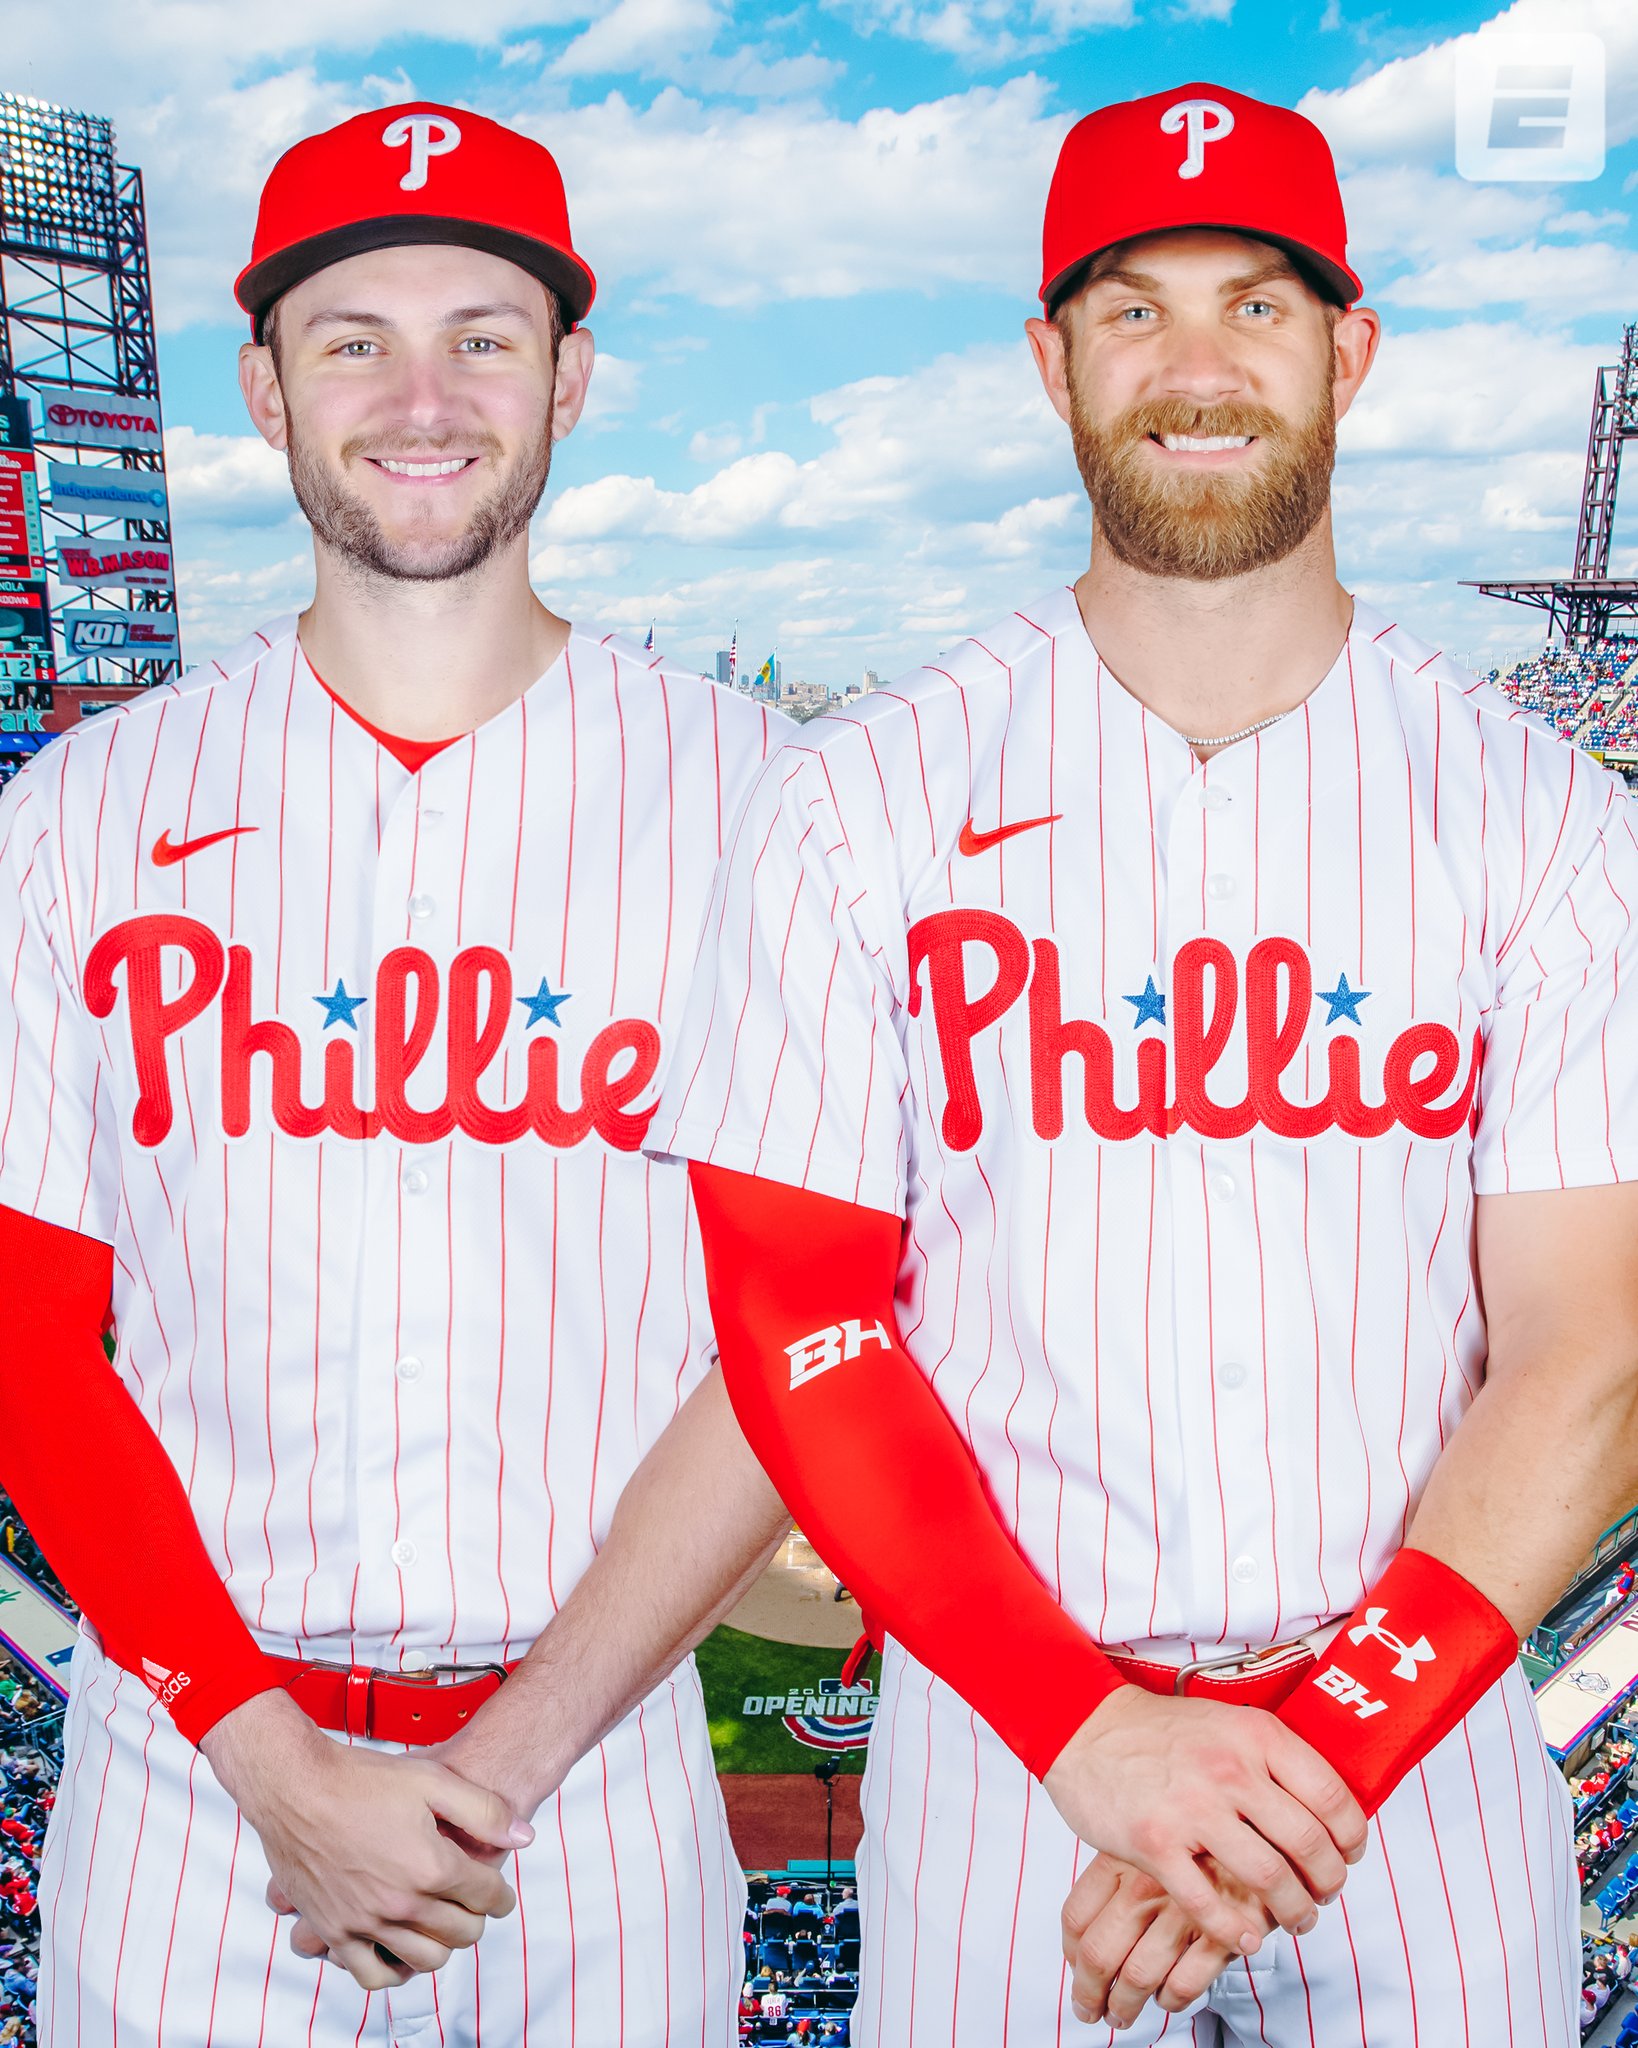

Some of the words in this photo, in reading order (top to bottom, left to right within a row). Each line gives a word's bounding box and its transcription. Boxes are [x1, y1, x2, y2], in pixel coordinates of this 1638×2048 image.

[1160, 99, 1235, 179] P
[382, 114, 461, 191] P
[76, 409, 158, 434] TOYOTA
[74, 622, 127, 646] KDI
[20, 661, 31, 677] 2
[783, 1319, 892, 1391] BH
[1312, 1664, 1389, 1719] BH
[742, 1696, 880, 1715] OPENING
[768, 2005, 781, 2017] 86
